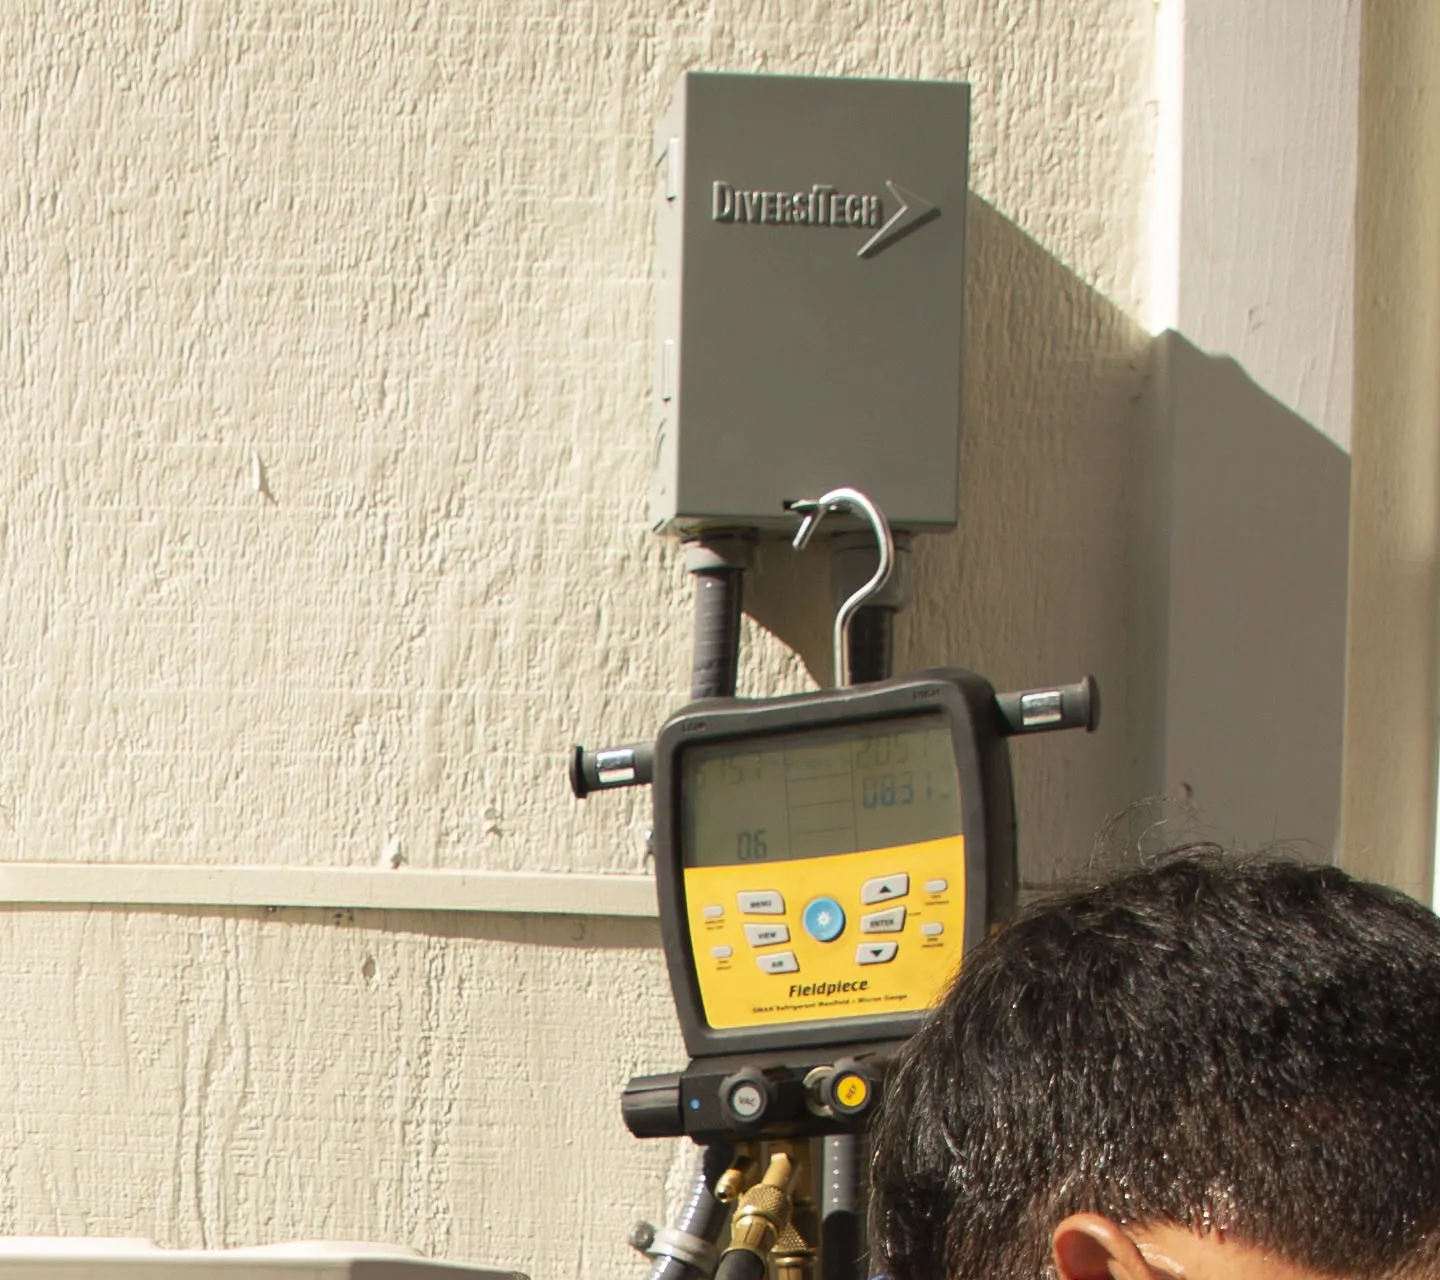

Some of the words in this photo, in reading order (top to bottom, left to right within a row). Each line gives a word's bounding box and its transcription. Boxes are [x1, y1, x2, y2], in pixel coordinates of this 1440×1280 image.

[750, 900, 772, 908] MENU
[869, 918, 894, 928] ENTER
[789, 980, 868, 997] Fieldpiece
